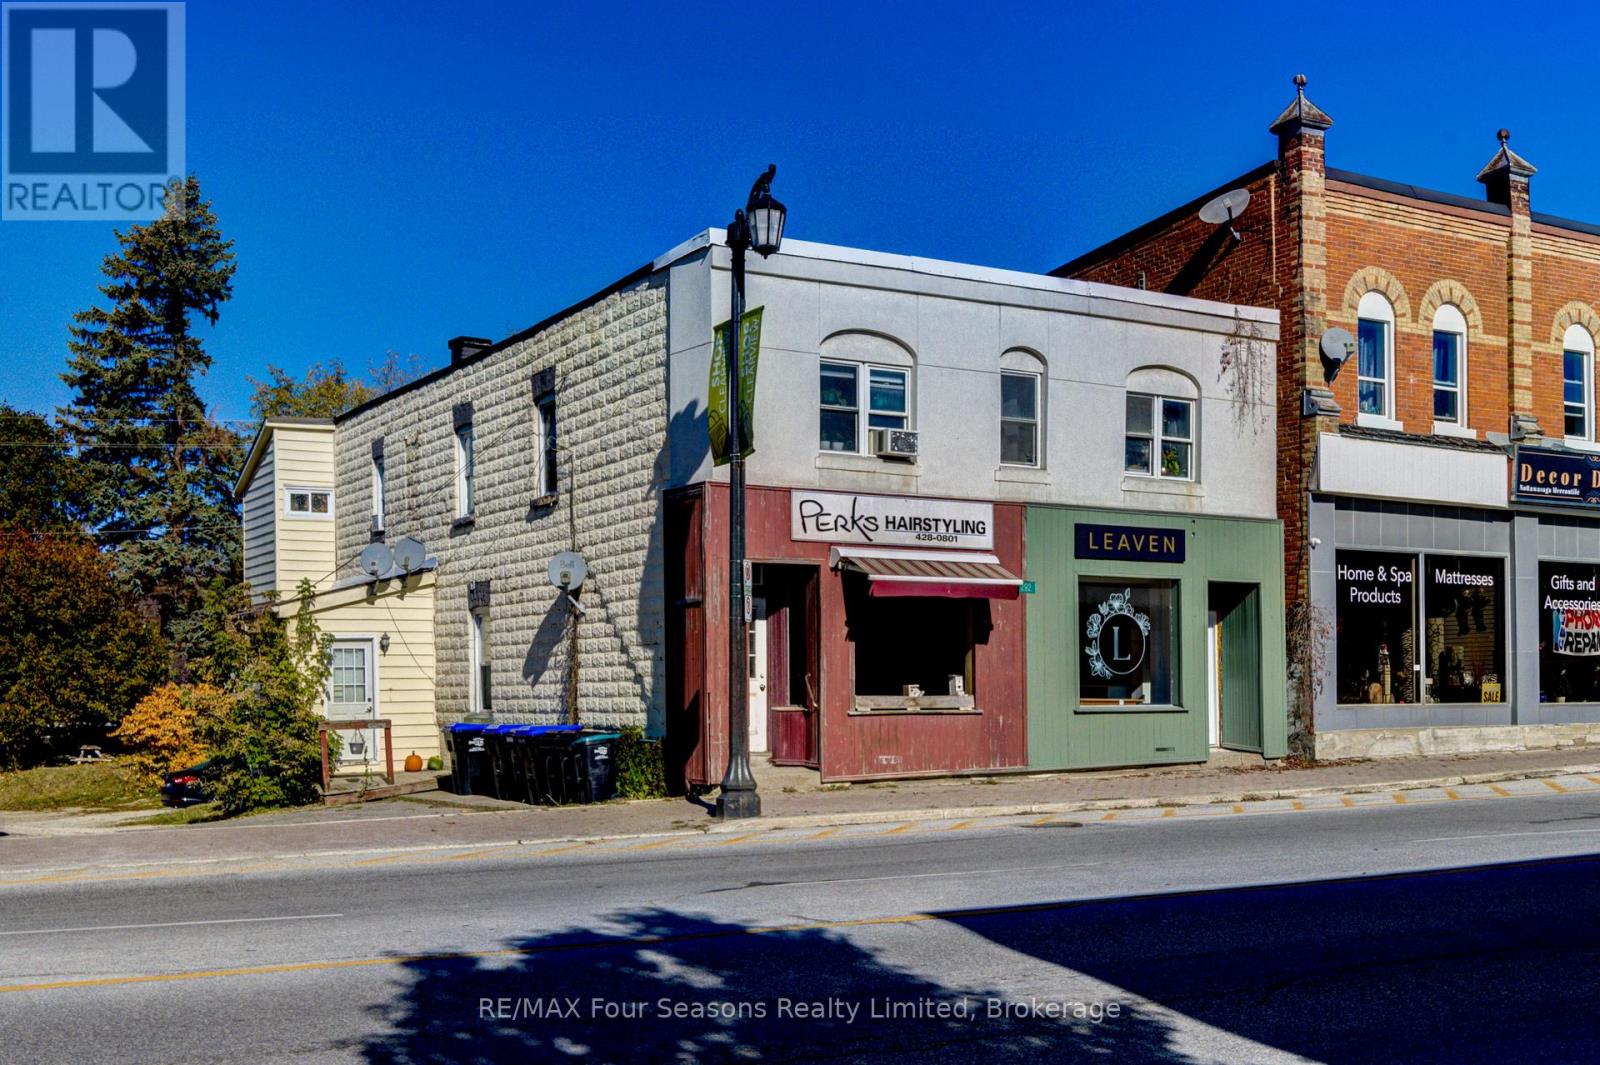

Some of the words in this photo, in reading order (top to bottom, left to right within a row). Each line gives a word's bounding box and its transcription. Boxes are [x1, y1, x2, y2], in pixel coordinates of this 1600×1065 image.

[741, 322, 751, 377] SHOP
[1520, 463, 1582, 487] Decor
[885, 515, 986, 535] HAIRSTYLING
[915, 533, 958, 543] 428-0801
[1089, 532, 1175, 553] LEAVEN
[1337, 564, 1374, 581] Home
[1377, 566, 1387, 582] &
[1390, 566, 1412, 586] Spa
[1435, 569, 1494, 586] Mattresses
[1550, 575, 1574, 591] Gifts
[1577, 576, 1595, 591] and
[1350, 587, 1401, 604] Products
[1112, 626, 1131, 661] L
[1483, 691, 1499, 703] SALE
